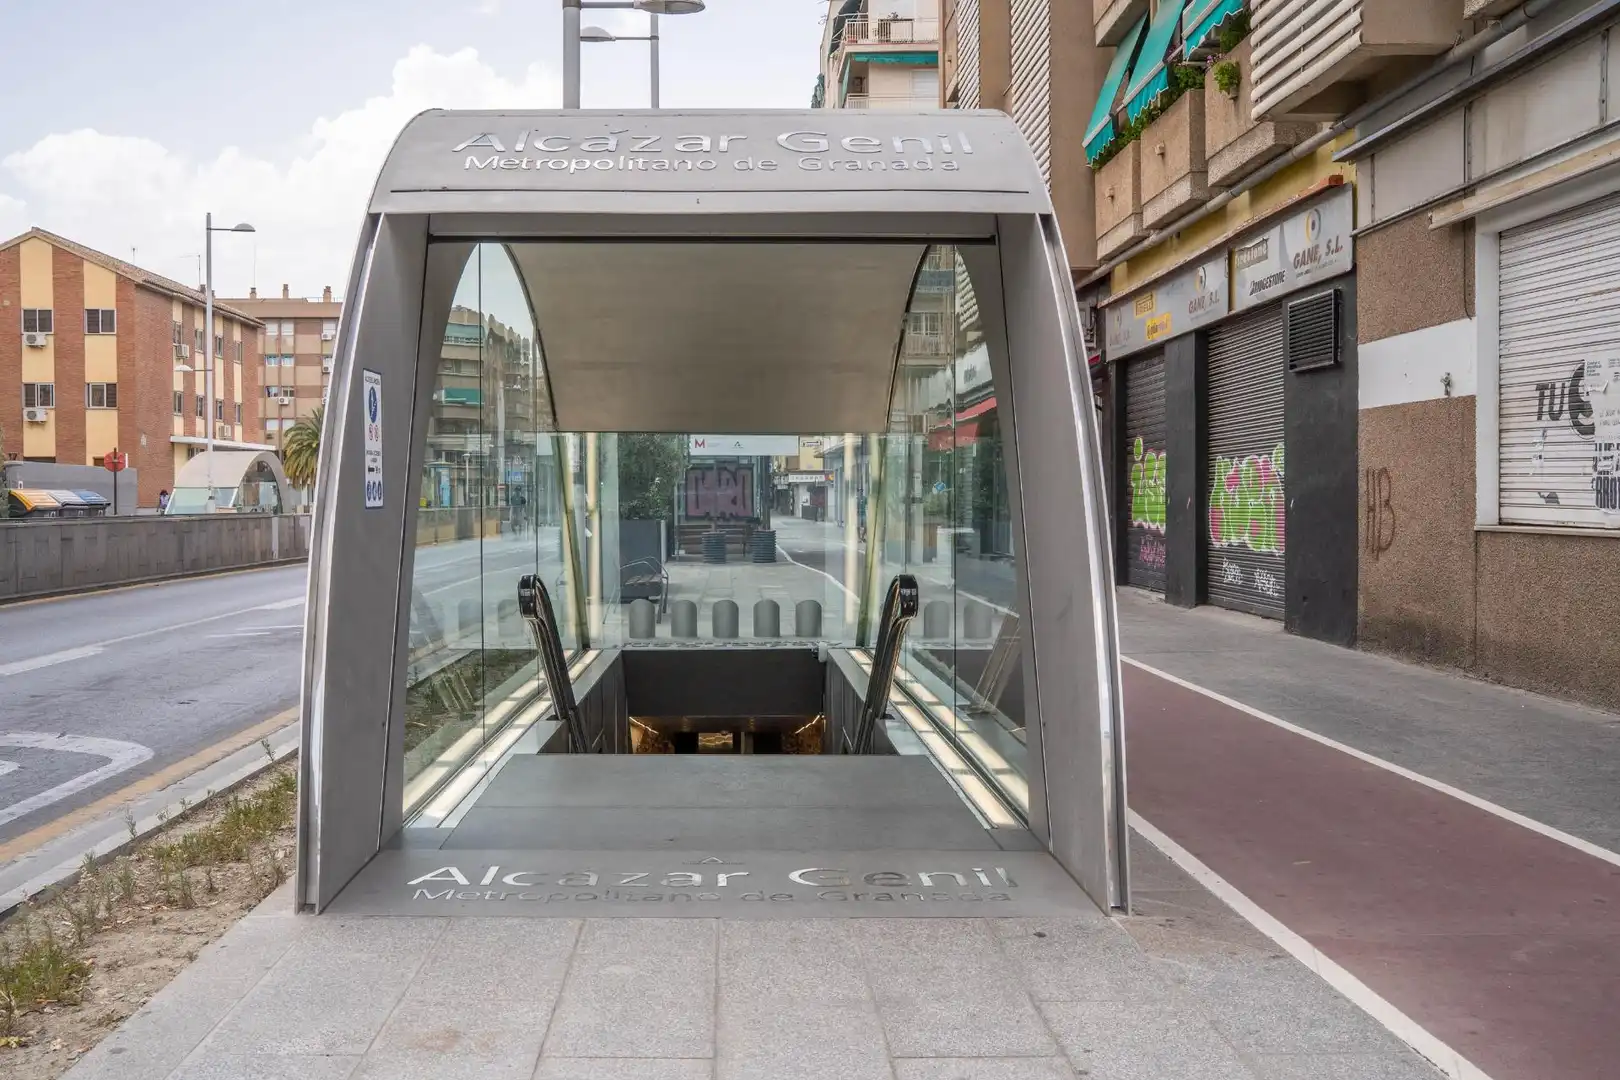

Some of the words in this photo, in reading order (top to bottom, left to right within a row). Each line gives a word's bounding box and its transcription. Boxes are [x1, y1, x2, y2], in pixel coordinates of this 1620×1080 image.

[451, 129, 748, 152] Alcázar
[776, 130, 973, 154] Genil
[464, 155, 717, 174] Metropolitano
[733, 156, 778, 171] de
[798, 156, 960, 171] Granada
[789, 867, 1018, 887] Genil
[741, 890, 794, 901] de
